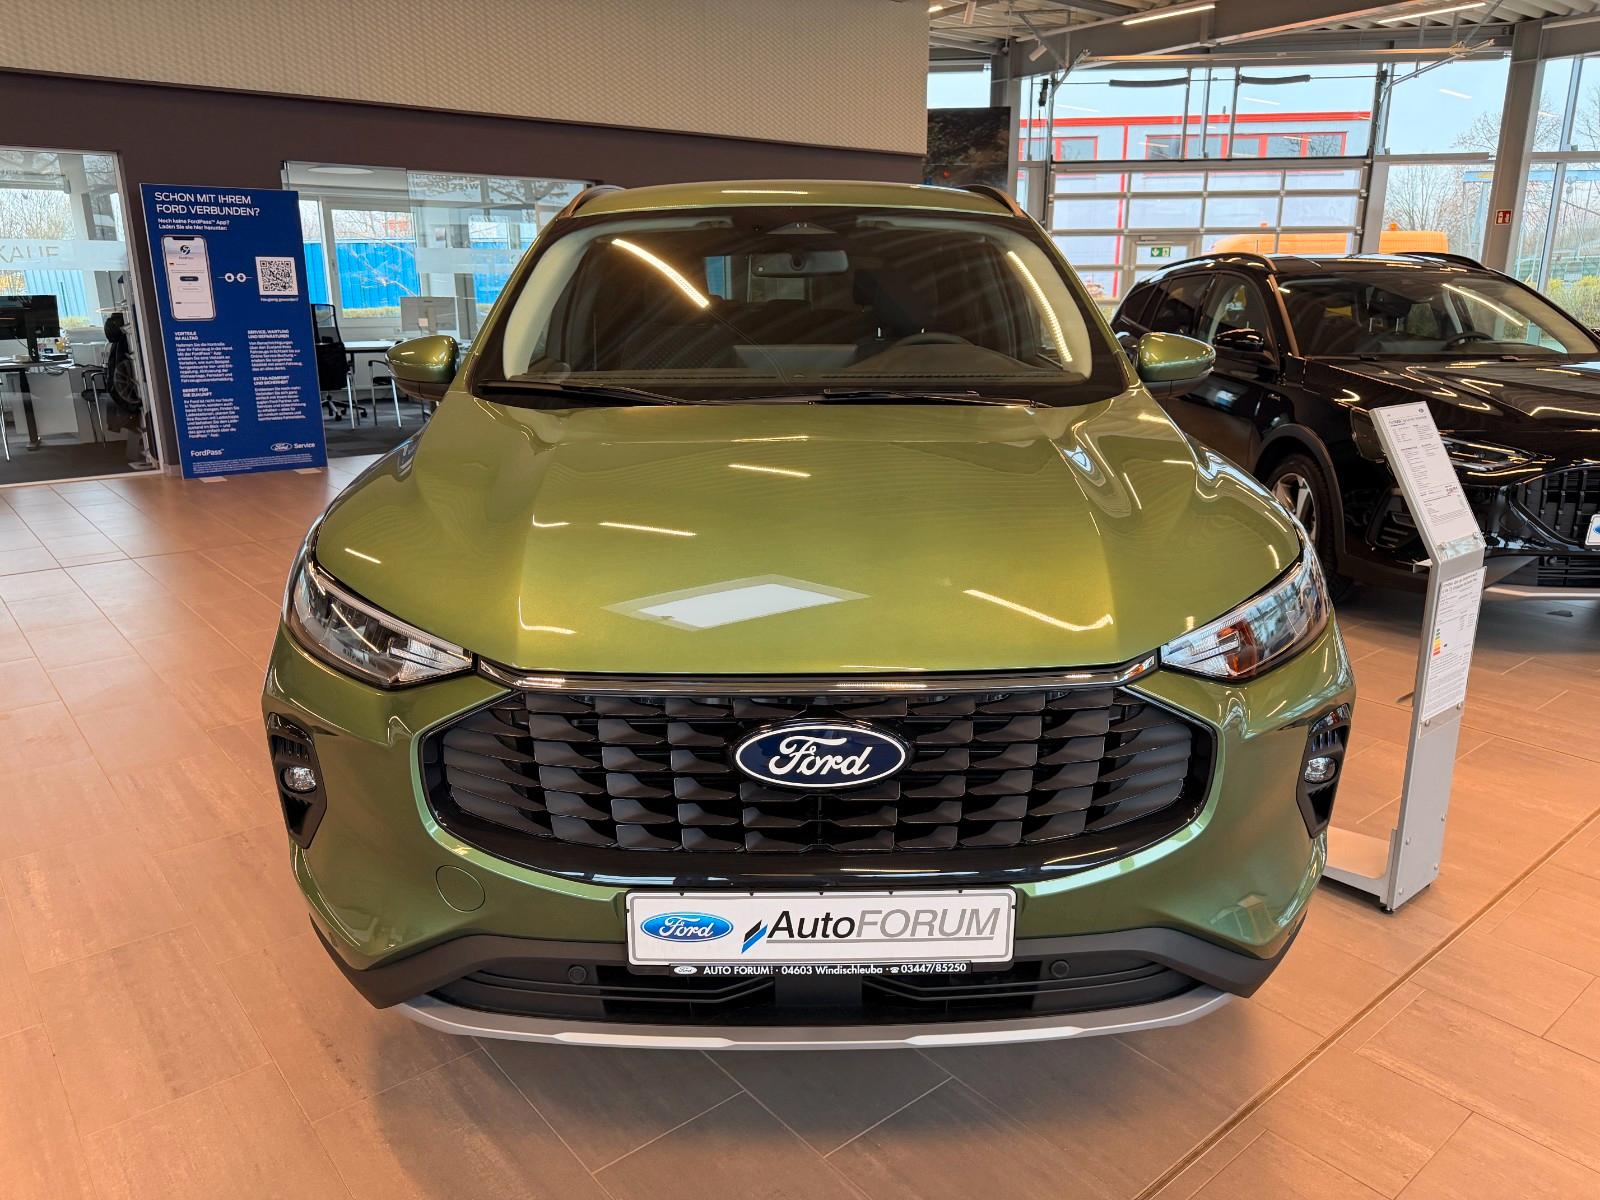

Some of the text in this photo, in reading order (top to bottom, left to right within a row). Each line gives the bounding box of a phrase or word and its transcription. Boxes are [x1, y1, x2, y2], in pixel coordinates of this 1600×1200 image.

[155, 192, 251, 204] SCHON MIT IHREM
[156, 204, 260, 216] FORD VERBUNDEN?
[769, 734, 870, 776] Ford
[659, 917, 714, 938] Ford
[703, 966, 731, 975] AUTO
[734, 966, 769, 975] FORUM
[781, 966, 812, 974] 04603
[816, 965, 883, 974] Windischleuba
[901, 963, 966, 974] 03447/85250
